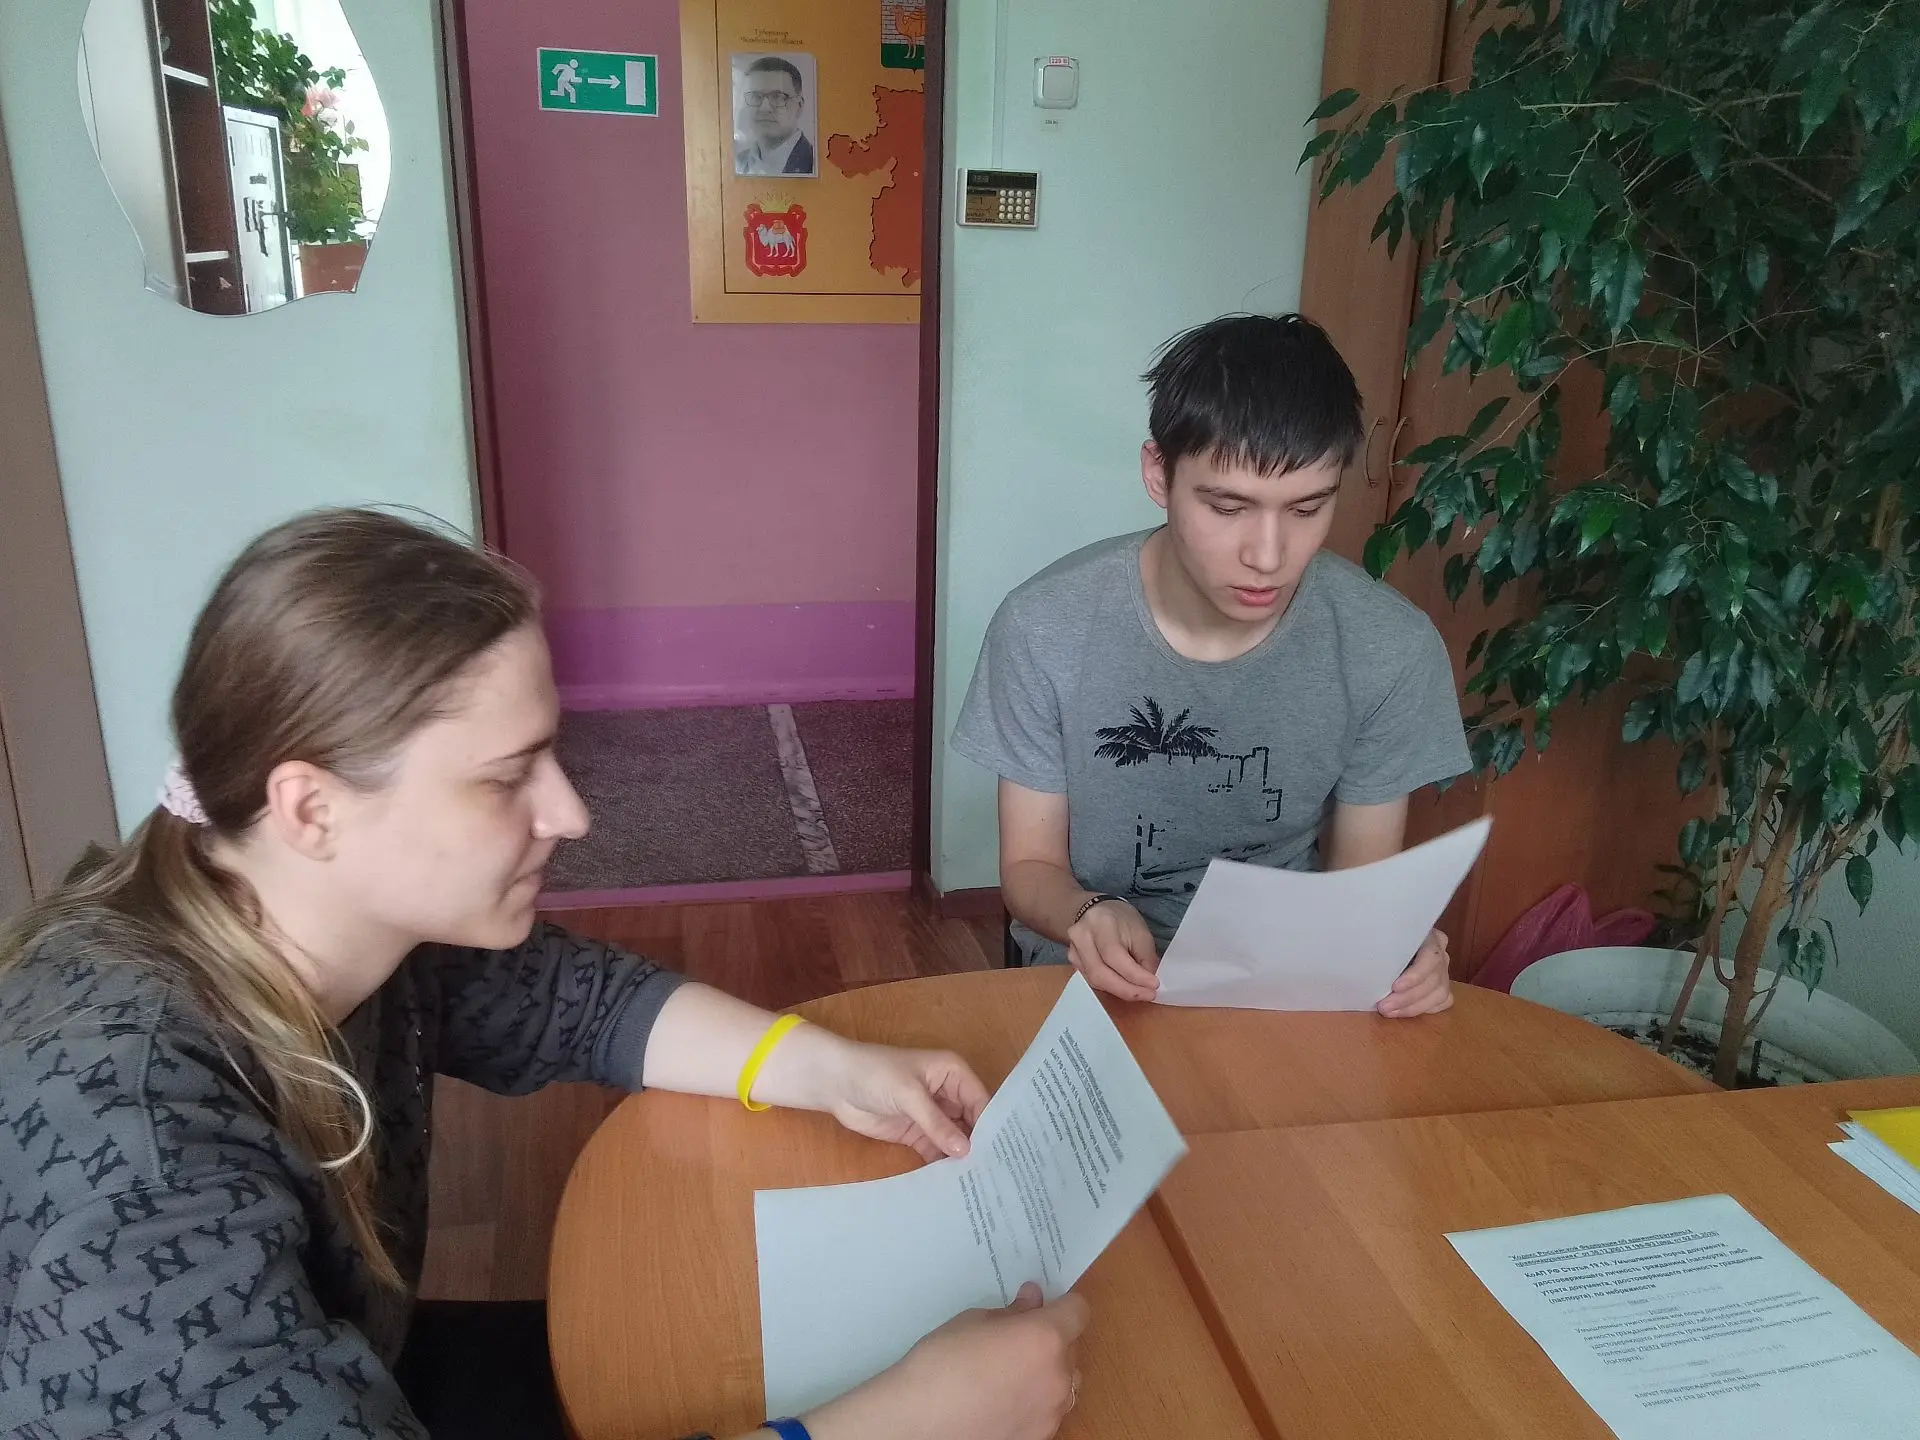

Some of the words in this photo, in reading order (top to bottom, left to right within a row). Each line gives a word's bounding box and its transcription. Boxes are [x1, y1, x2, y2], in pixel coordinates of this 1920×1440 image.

[1612, 1254, 1662, 1264] Умышленная
[1686, 1242, 1728, 1253] документа,
[1533, 1272, 1604, 1286] удостоверяющего
[1605, 1266, 1641, 1276] личность
[1641, 1259, 1685, 1270] гражданина
[1541, 1287, 1568, 1295] утрата
[1568, 1281, 1612, 1291] документа,
[1612, 1269, 1682, 1284] удостоверяющего
[1682, 1263, 1718, 1273] личность
[1719, 1255, 1763, 1266] гражданина
[1605, 1283, 1656, 1295] небрежности
